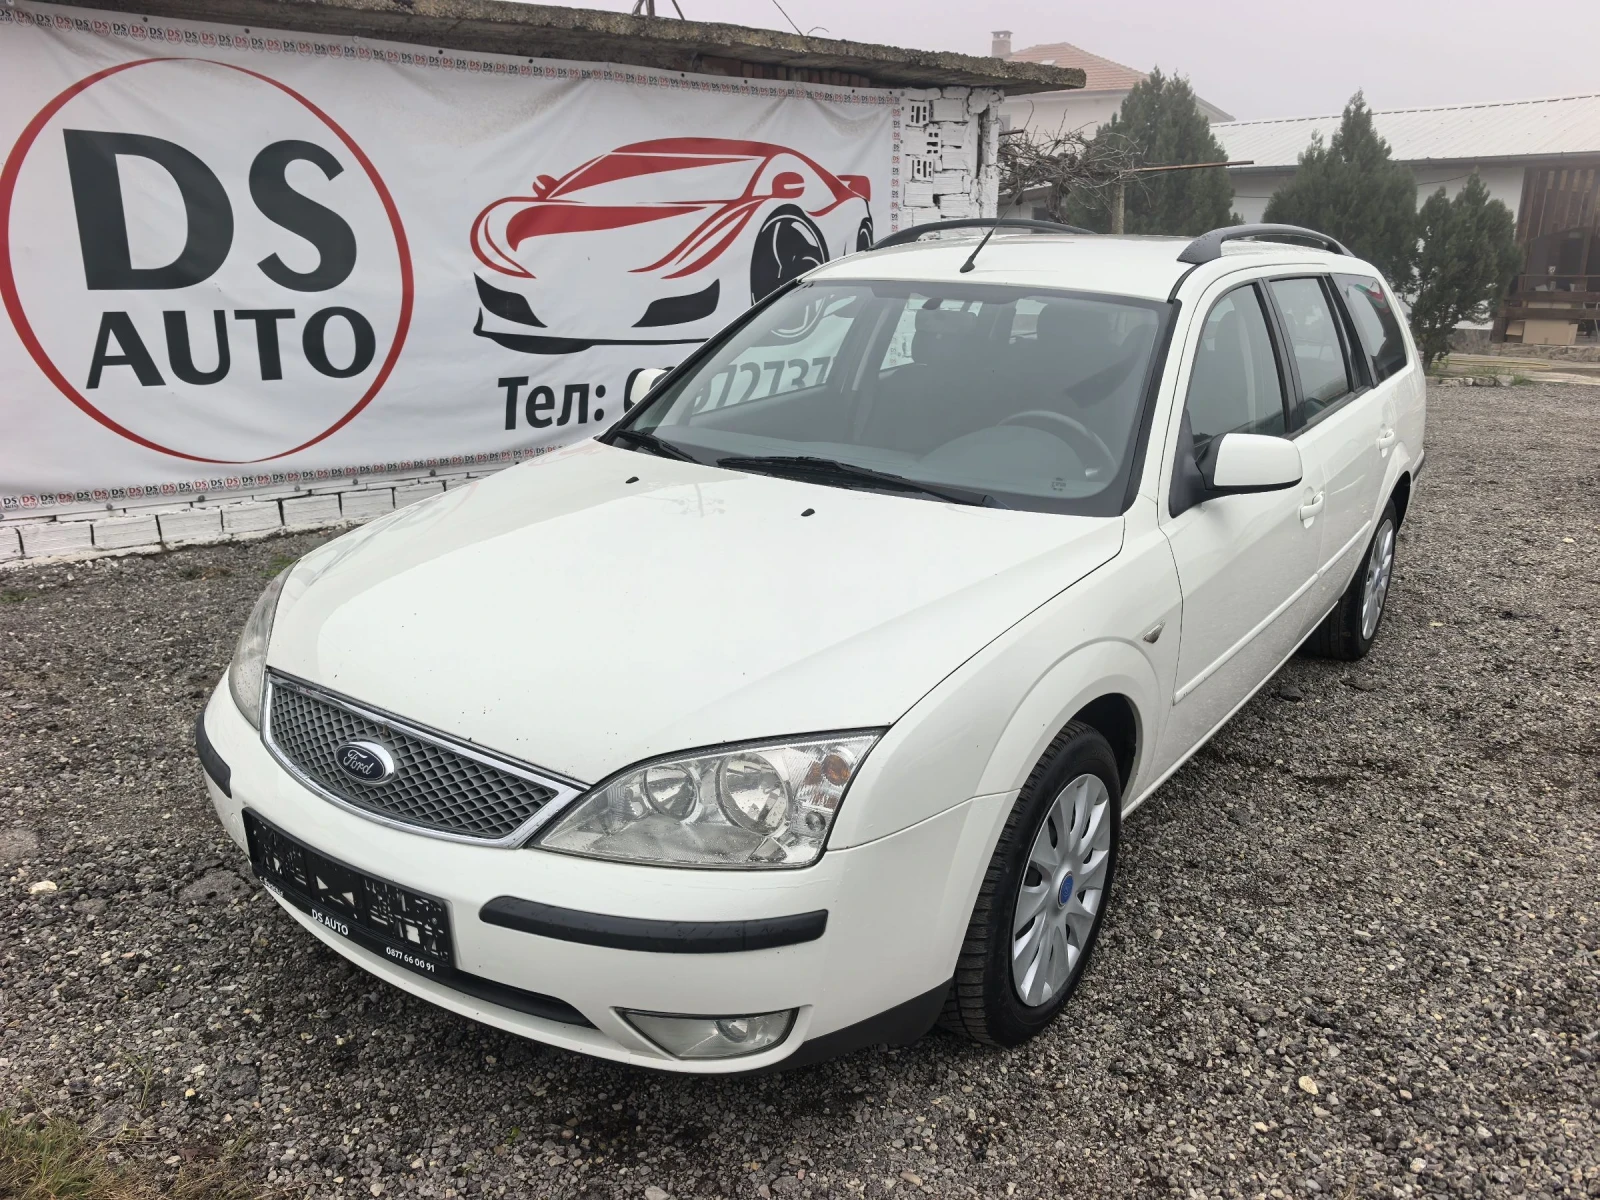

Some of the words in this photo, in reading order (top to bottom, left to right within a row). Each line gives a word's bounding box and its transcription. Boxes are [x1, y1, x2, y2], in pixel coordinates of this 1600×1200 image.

[63, 128, 357, 292] DS
[86, 306, 376, 389] AUTO
[497, 376, 606, 430] Тел:
[343, 749, 375, 775] Ford
[312, 909, 323, 923] DS
[325, 916, 348, 936] AUTO
[386, 946, 402, 959] 0877
[404, 954, 414, 964] 66
[415, 958, 424, 968] 00
[426, 962, 435, 972] 91
